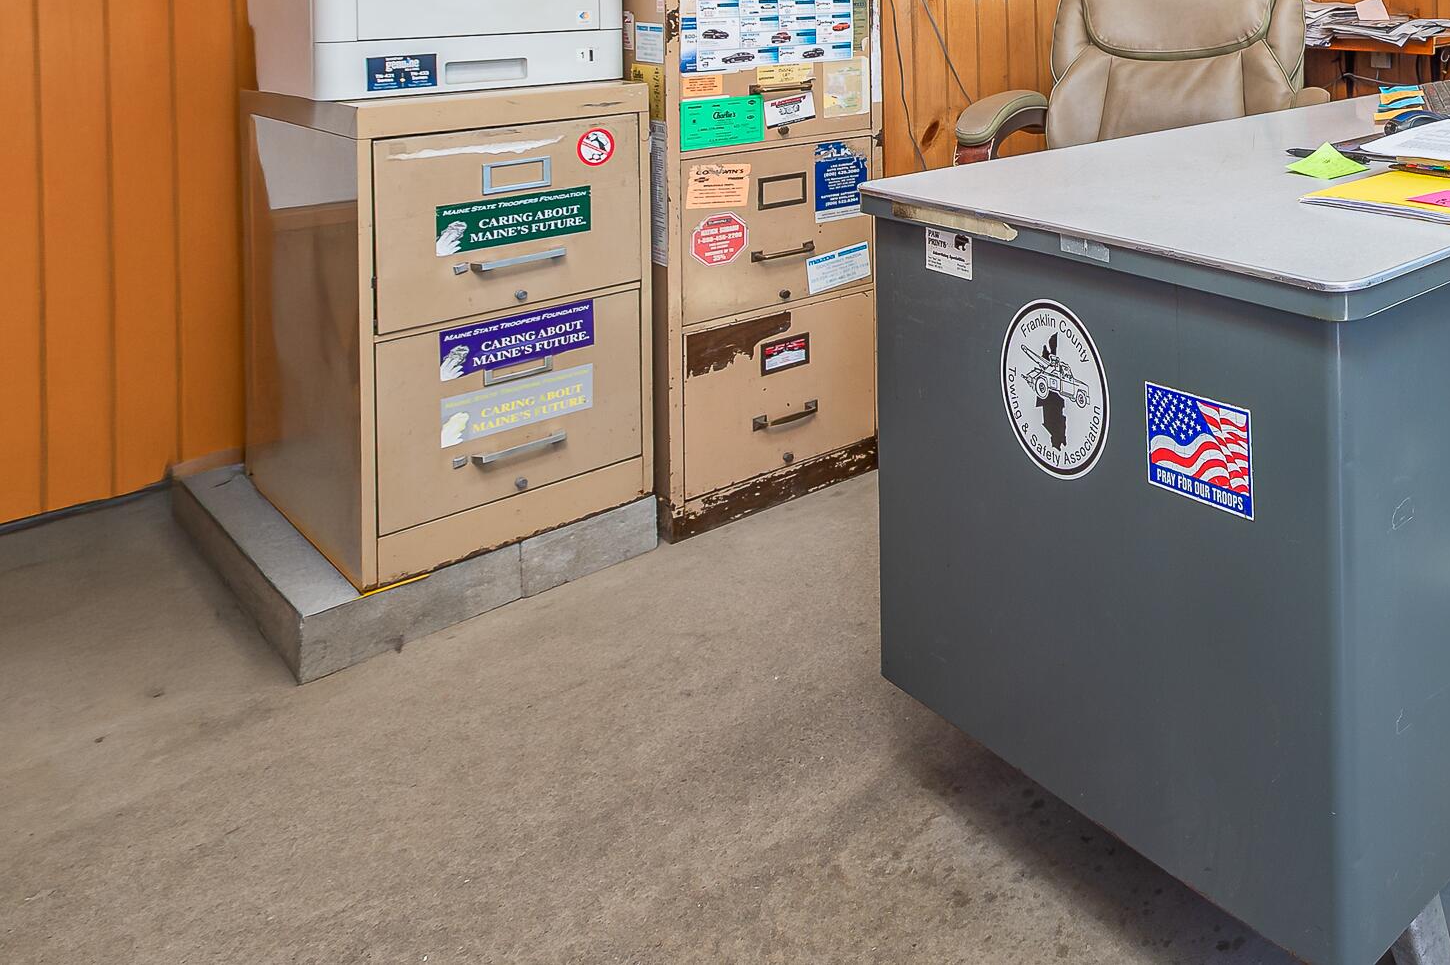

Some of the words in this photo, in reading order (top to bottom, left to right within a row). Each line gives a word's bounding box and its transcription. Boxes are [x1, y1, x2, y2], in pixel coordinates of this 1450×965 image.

[442, 208, 471, 216] MAINE
[471, 204, 496, 212] STATE
[498, 198, 538, 208] TROOPERS
[539, 191, 586, 202] FOUNDATION
[478, 212, 532, 228] CARING
[534, 205, 580, 220] ABOUT
[470, 225, 528, 243] MAINE'S
[532, 216, 586, 232] FUTURE.
[808, 254, 836, 266] mazda
[444, 332, 472, 342] MAINE
[472, 325, 500, 336] STATE
[500, 315, 541, 329] TROOPERS
[542, 305, 590, 320] FOUNDATION
[481, 332, 536, 352] CARING
[538, 320, 584, 340] ABOUT
[1020, 313, 1056, 338] Franklin
[1058, 320, 1090, 364] County
[472, 344, 533, 367] MAINE'S
[536, 332, 590, 352] FUTURE.
[481, 397, 535, 418] CARING
[538, 384, 583, 401] ABOUT
[1008, 366, 1022, 420] Towing
[1022, 422, 1029, 434] &
[1030, 434, 1061, 466] Safety
[1064, 406, 1101, 466] Association
[472, 410, 532, 432] MAINE'S
[1156, 468, 1176, 487] PRAY
[1178, 474, 1192, 492] FOR
[1194, 482, 1210, 499] OUR
[1212, 488, 1244, 511] TROOPS
